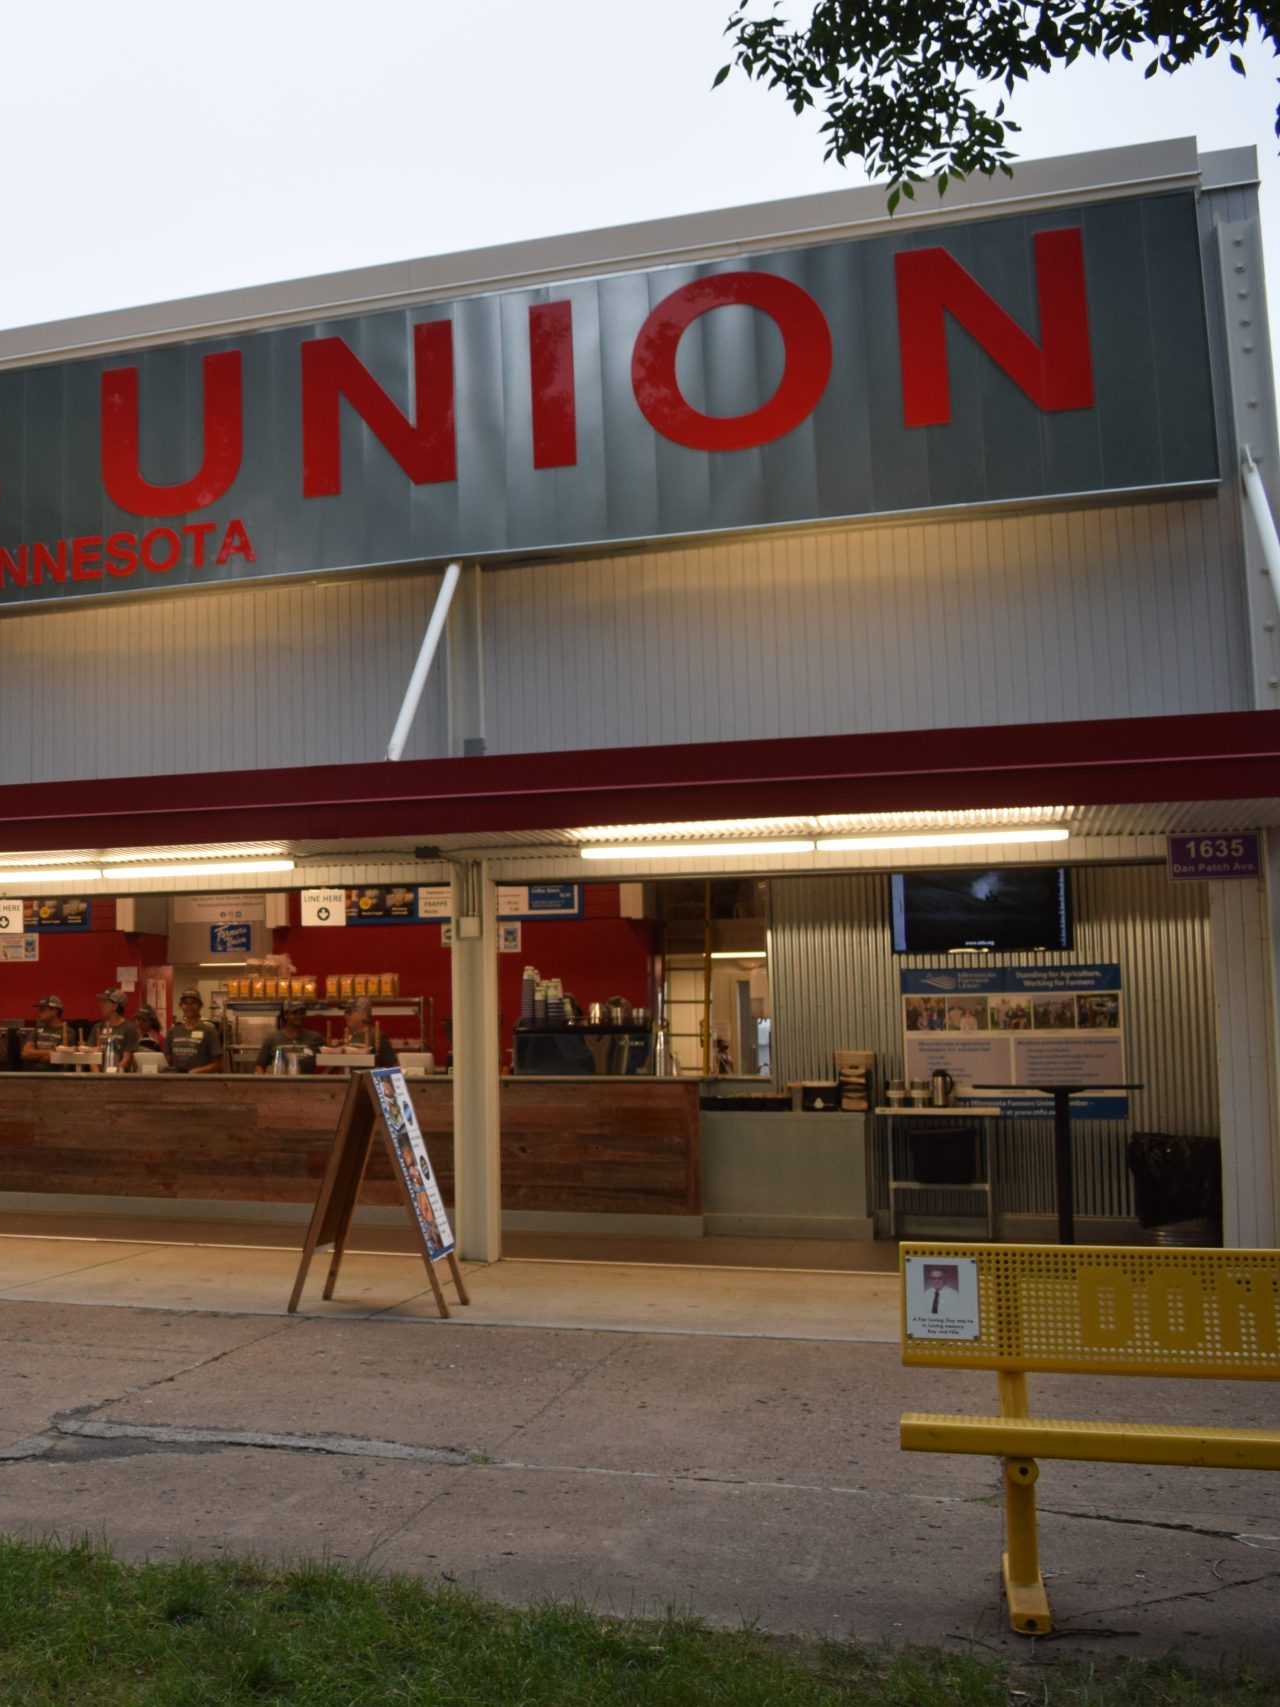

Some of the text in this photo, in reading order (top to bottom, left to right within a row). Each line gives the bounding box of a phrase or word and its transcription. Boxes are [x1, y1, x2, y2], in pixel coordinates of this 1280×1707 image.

[101, 227, 1095, 517] UNION
[1185, 838, 1244, 858] 1635
[1173, 861, 1257, 873] Dan Patch Ave.
[324, 895, 344, 903] HERE
